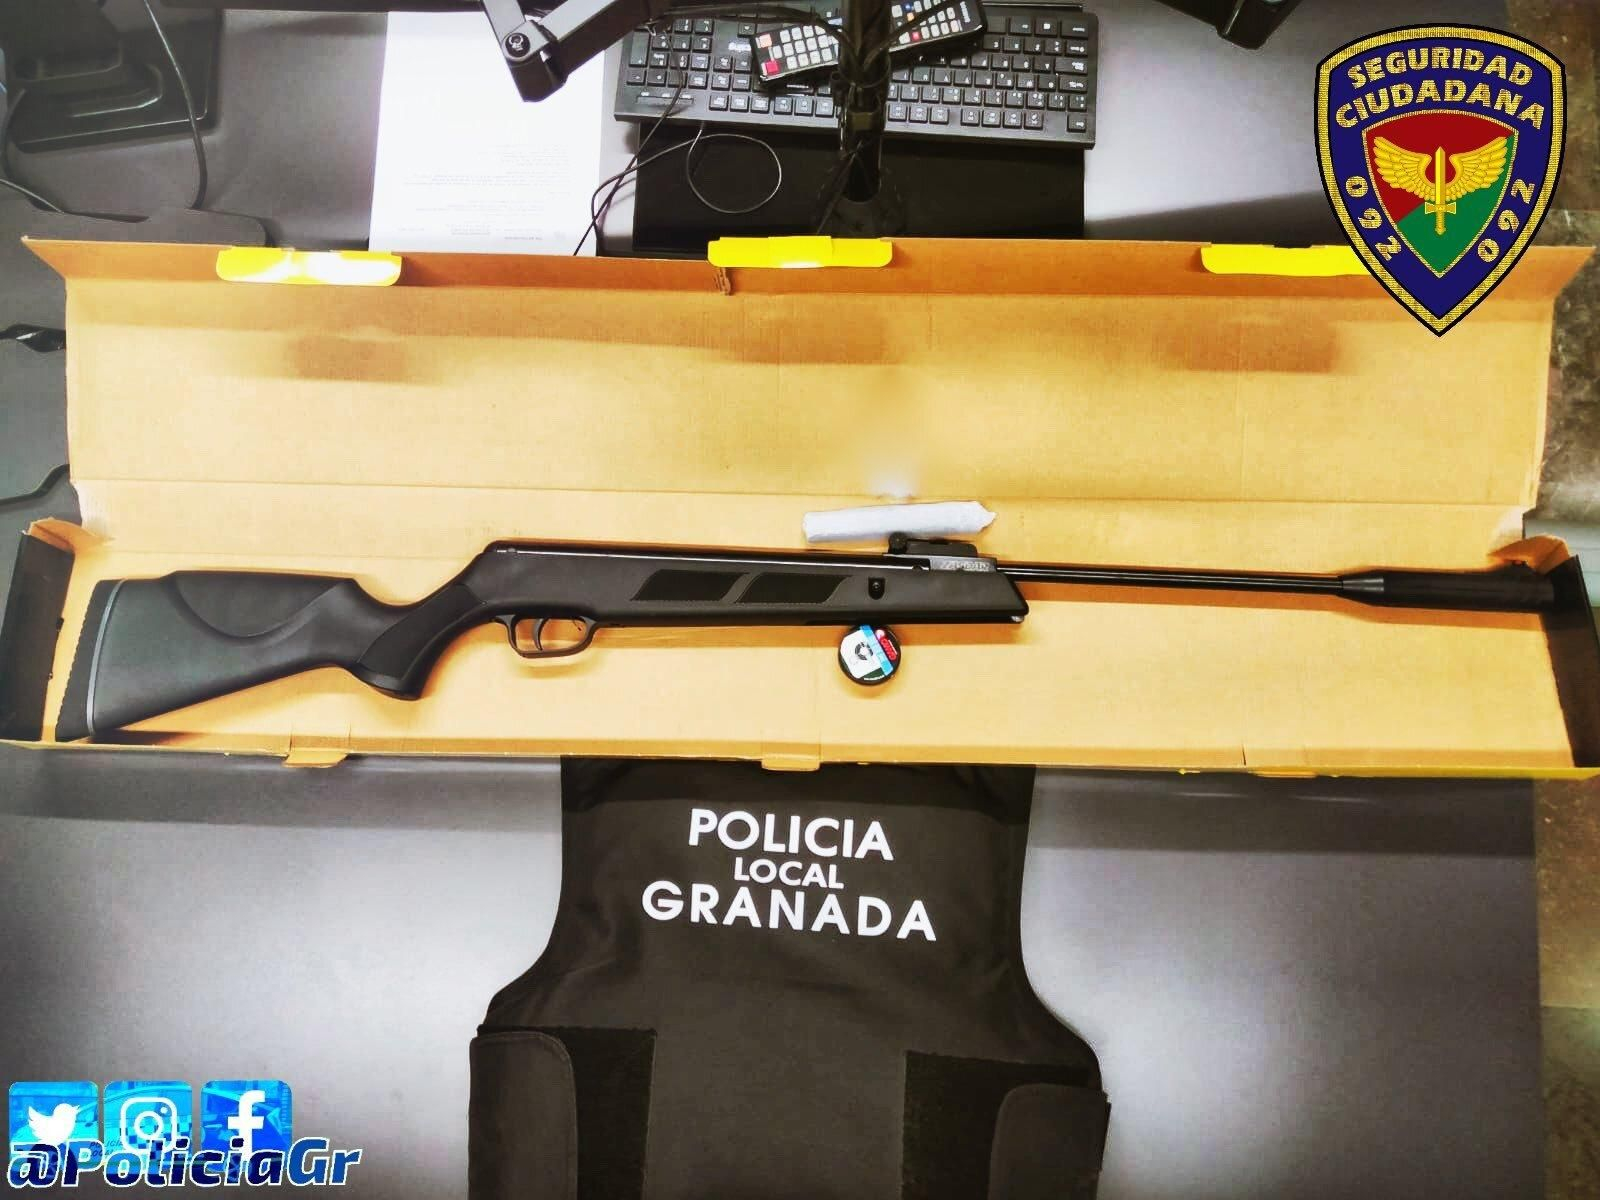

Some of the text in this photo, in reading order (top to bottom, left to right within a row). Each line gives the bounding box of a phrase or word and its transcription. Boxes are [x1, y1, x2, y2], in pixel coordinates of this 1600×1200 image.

[688, 808, 894, 861] POLICIA
[733, 857, 845, 889] LOCAL
[641, 880, 937, 942] GRANADA
